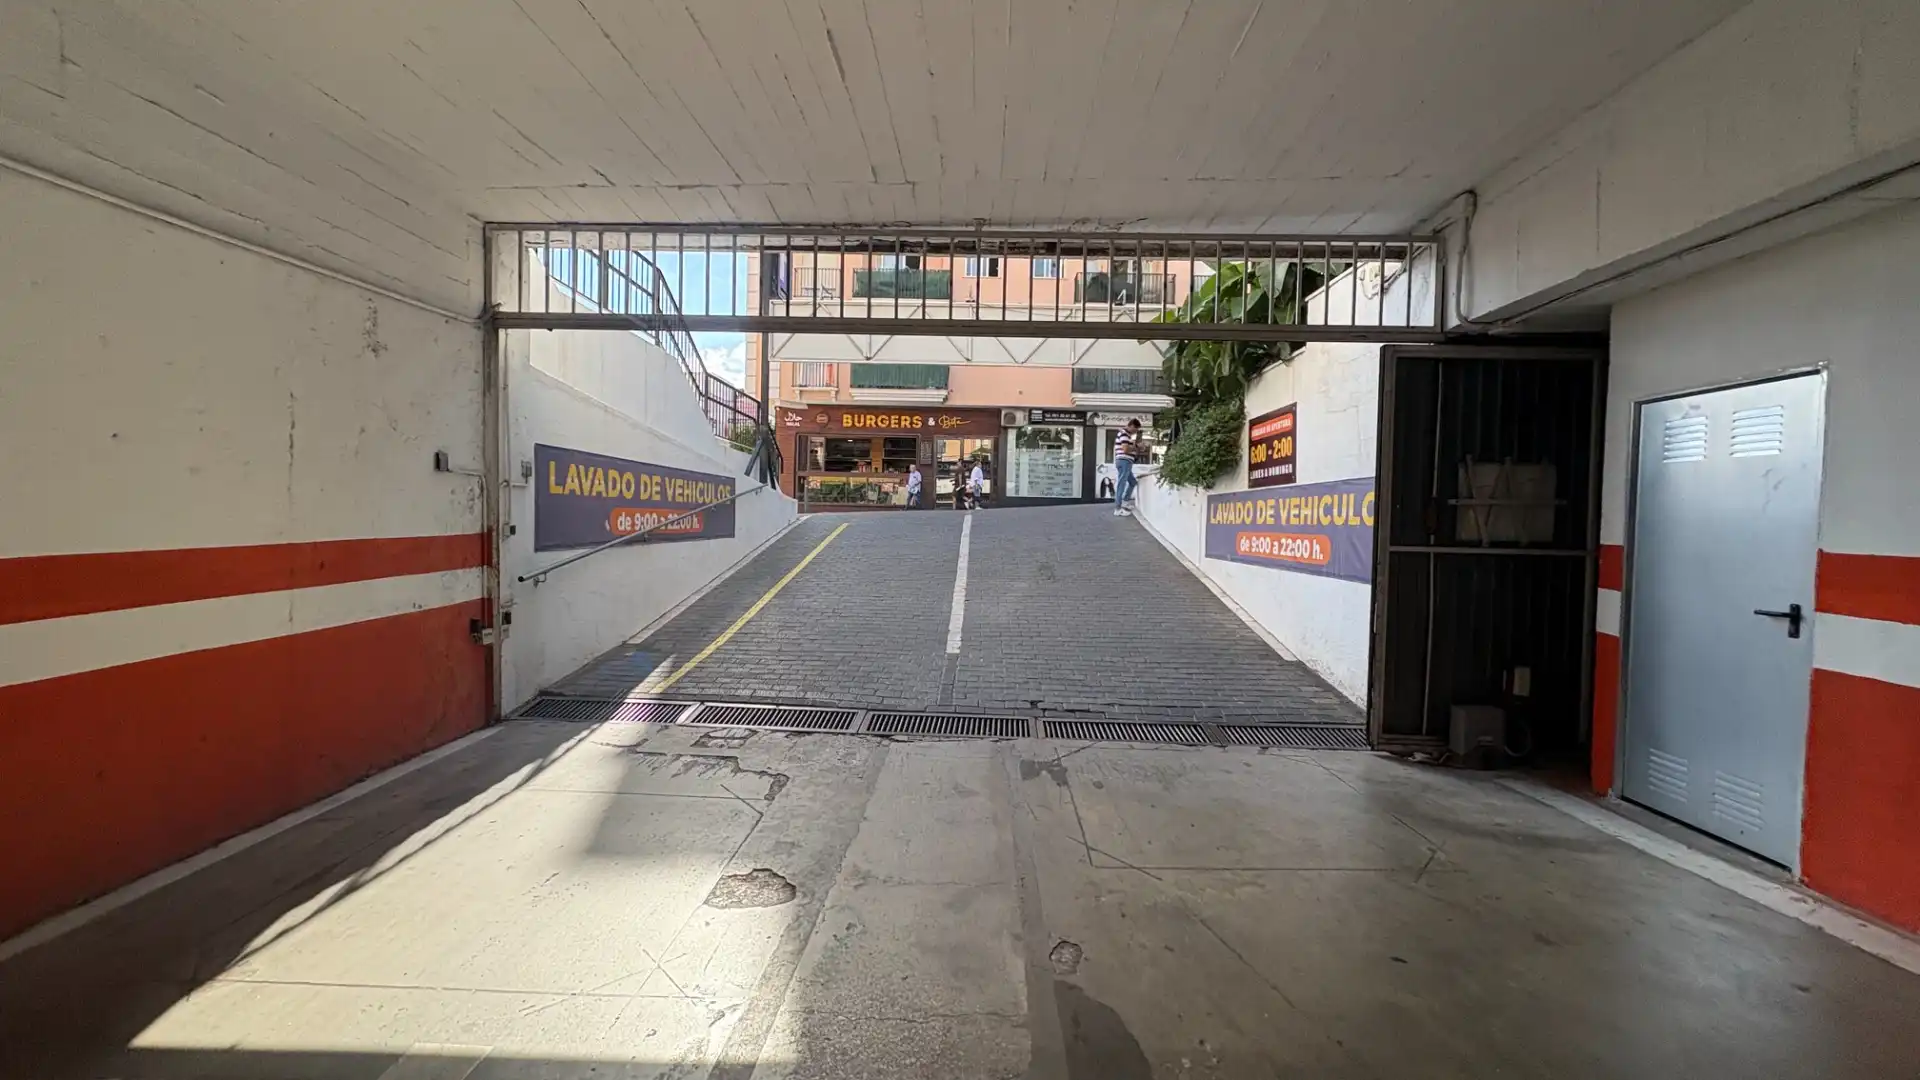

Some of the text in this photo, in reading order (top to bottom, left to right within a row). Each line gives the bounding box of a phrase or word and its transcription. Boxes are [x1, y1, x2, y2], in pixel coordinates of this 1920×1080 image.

[842, 413, 923, 429] BURGERS
[927, 417, 936, 426] &
[1271, 418, 1291, 431] APERTURA
[1250, 443, 1267, 464] 6:00
[1273, 436, 1292, 459] 2:00
[549, 460, 731, 504] LAVADO DE VEHICULOS
[1250, 463, 1292, 479] LUNES A DOMINGO
[617, 511, 632, 531] de
[634, 512, 658, 531] 9:00
[667, 513, 692, 530] 22:00
[692, 514, 700, 529] h.
[1210, 499, 1253, 525] LAVADO
[1256, 498, 1275, 525] DE
[1240, 535, 1324, 560] de 9:00 a 22:00 h.
